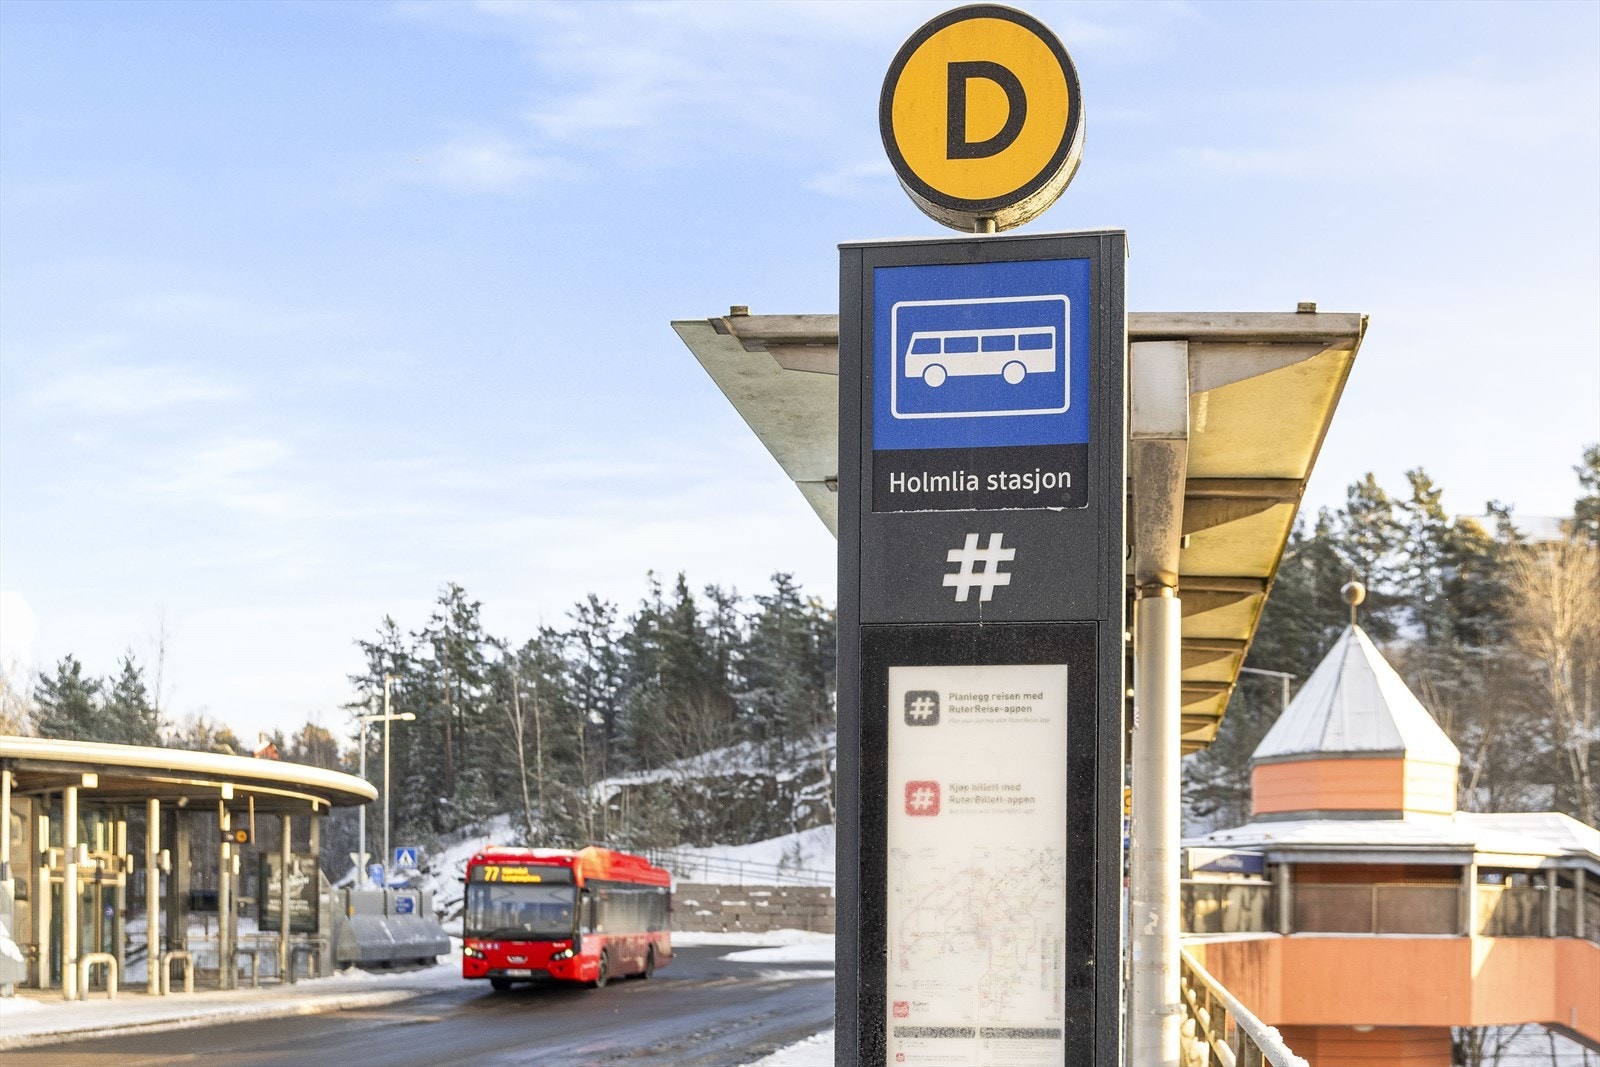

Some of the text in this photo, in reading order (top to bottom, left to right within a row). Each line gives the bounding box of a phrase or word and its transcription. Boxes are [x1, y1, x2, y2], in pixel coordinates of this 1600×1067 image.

[947, 60, 1027, 160] D
[889, 467, 1072, 496] Holmlia stasjon
[949, 691, 1044, 702] Planlegg reisen med
[1002, 783, 1022, 792] med
[484, 866, 499, 881] 77
